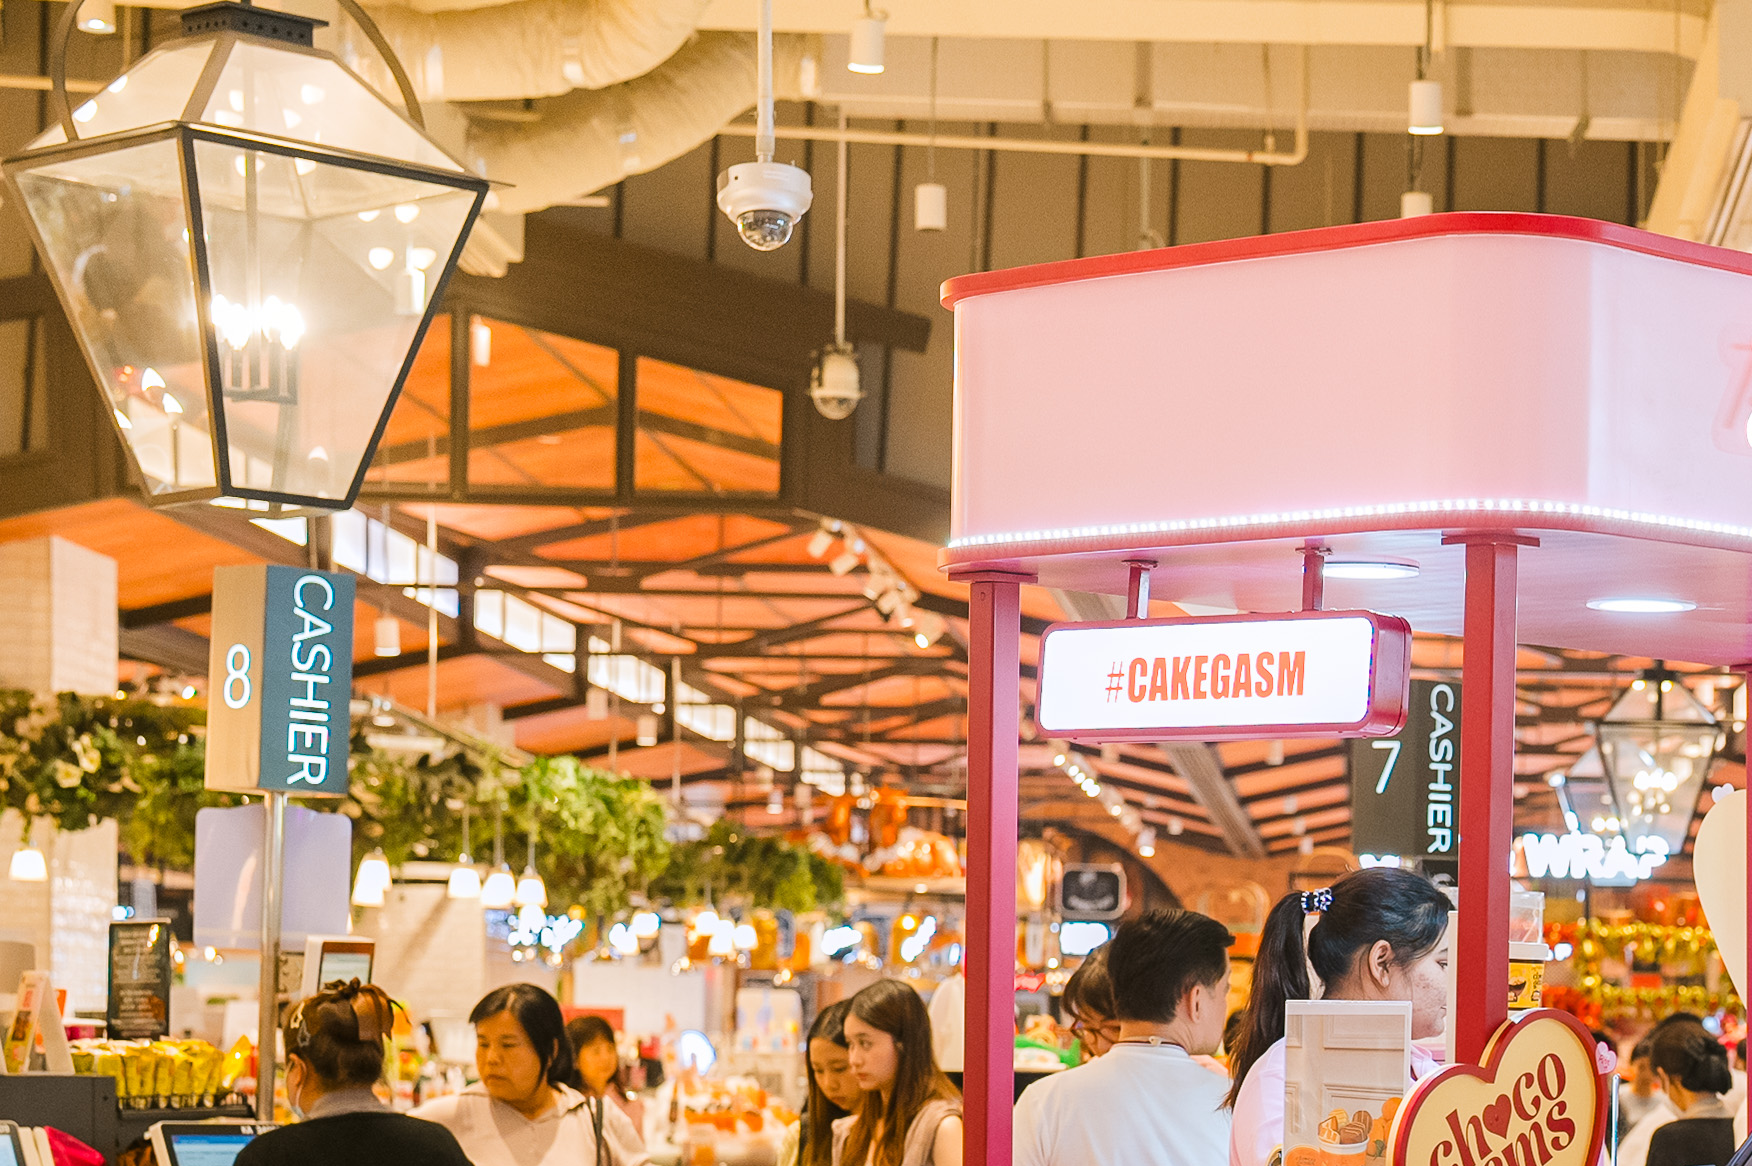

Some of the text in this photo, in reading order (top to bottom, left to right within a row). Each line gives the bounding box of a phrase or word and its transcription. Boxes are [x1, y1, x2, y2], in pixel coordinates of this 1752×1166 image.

[223, 643, 252, 710] 8
[285, 573, 336, 787] CASHIER
[1104, 650, 1307, 705] #CAKEGASM
[1370, 740, 1401, 795] 7
[1427, 683, 1455, 854] CASHIER
